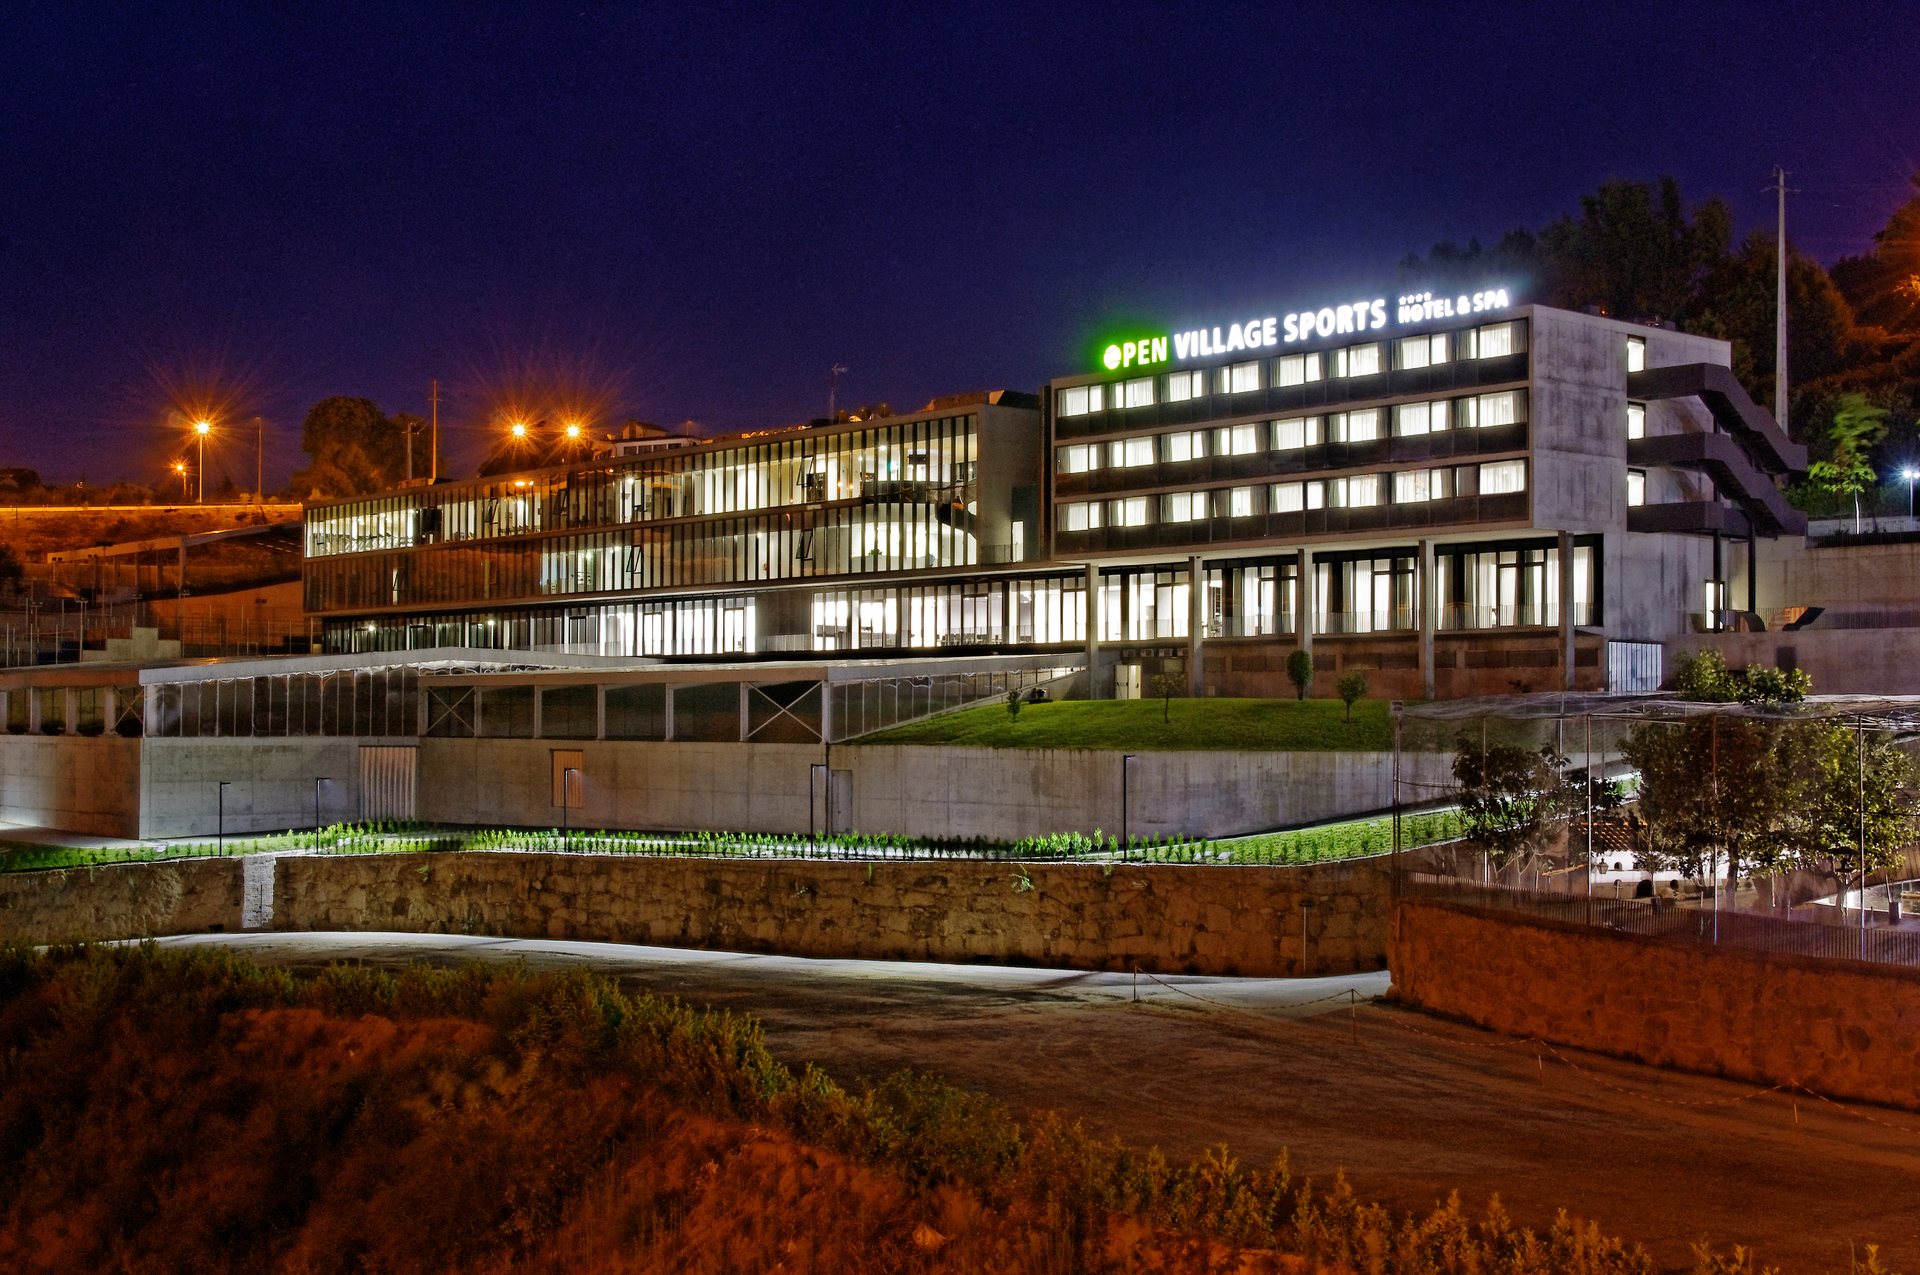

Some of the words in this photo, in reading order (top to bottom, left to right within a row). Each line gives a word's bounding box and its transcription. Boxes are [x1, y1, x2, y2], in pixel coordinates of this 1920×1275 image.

[1398, 298, 1455, 324] HOTEL
[1456, 295, 1471, 315] &
[1473, 288, 1510, 313] SPA
[1103, 336, 1168, 370] OPEN
[1173, 317, 1278, 360] VILLAGE
[1283, 299, 1387, 343] SPORTS
